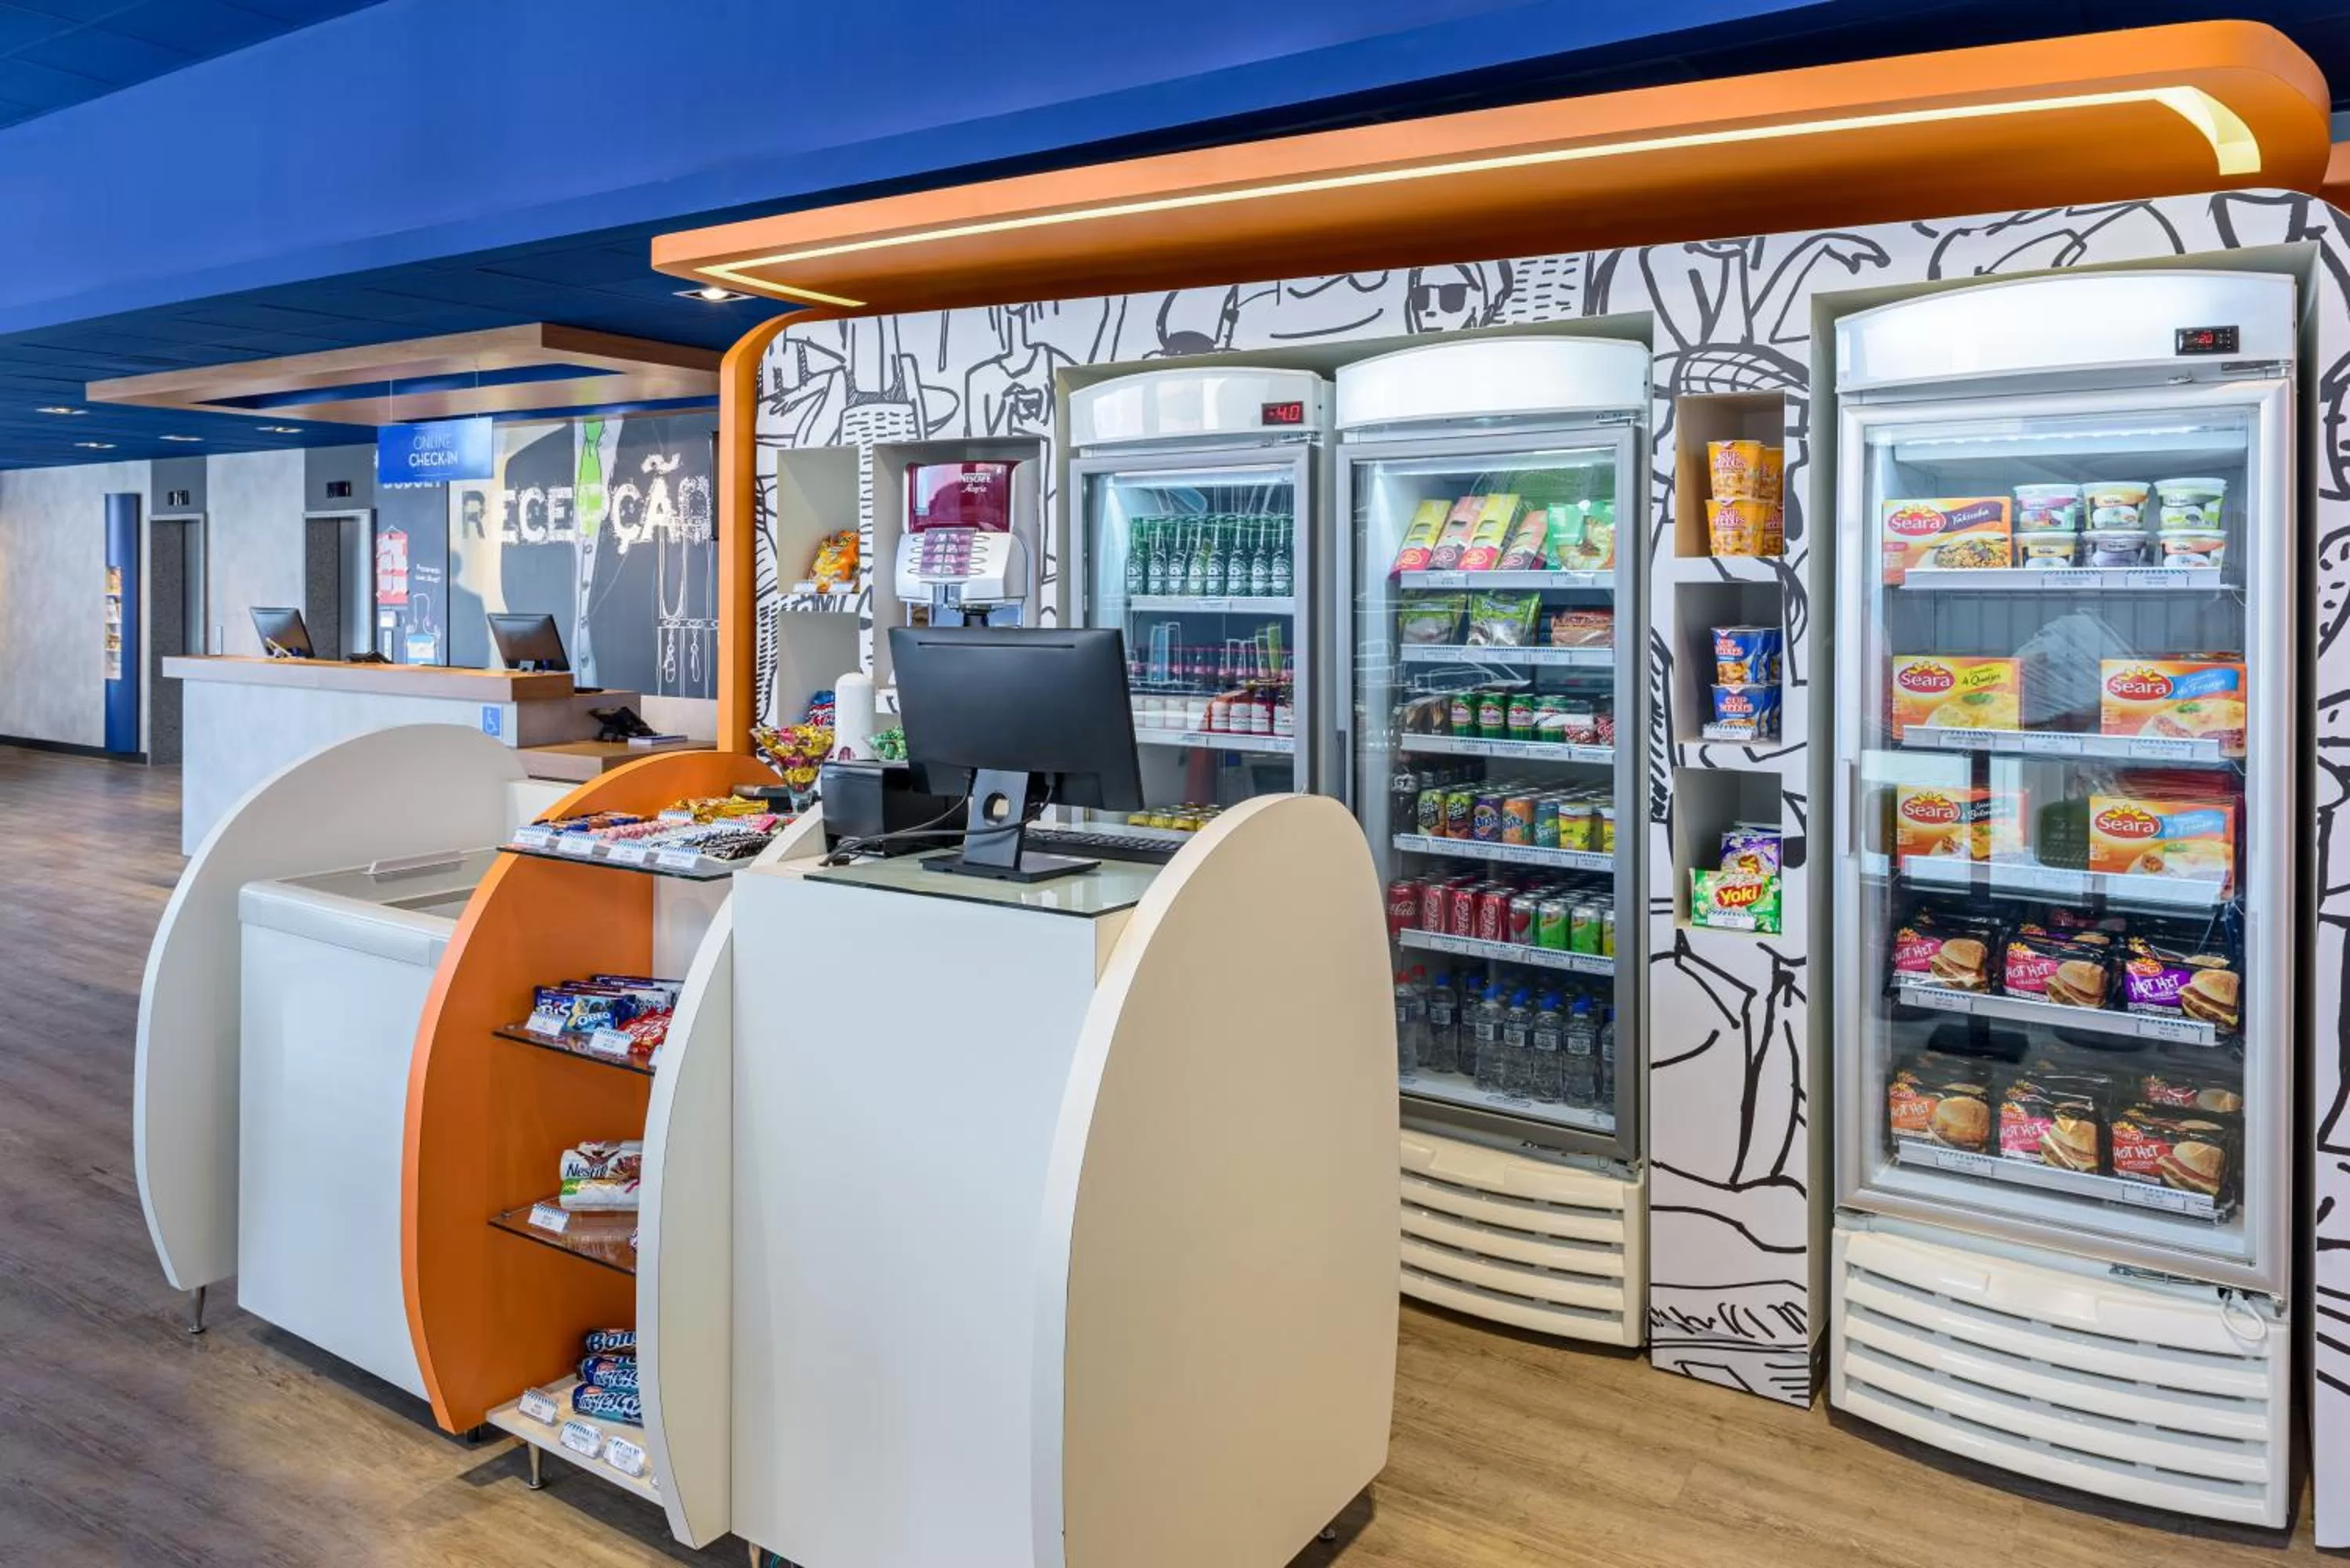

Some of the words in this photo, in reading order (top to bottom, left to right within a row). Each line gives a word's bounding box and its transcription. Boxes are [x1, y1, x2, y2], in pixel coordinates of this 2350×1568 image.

[414, 433, 452, 450] ONLINE
[408, 450, 458, 467] CHECK-IN
[1890, 517, 1941, 530] Seara
[1900, 673, 1950, 687] Seara
[2109, 677, 2167, 695] Seara
[1904, 803, 1955, 819] Seara
[2097, 816, 2155, 833] Seara
[577, 1011, 611, 1025] OREO
[588, 1331, 637, 1353] Bon
